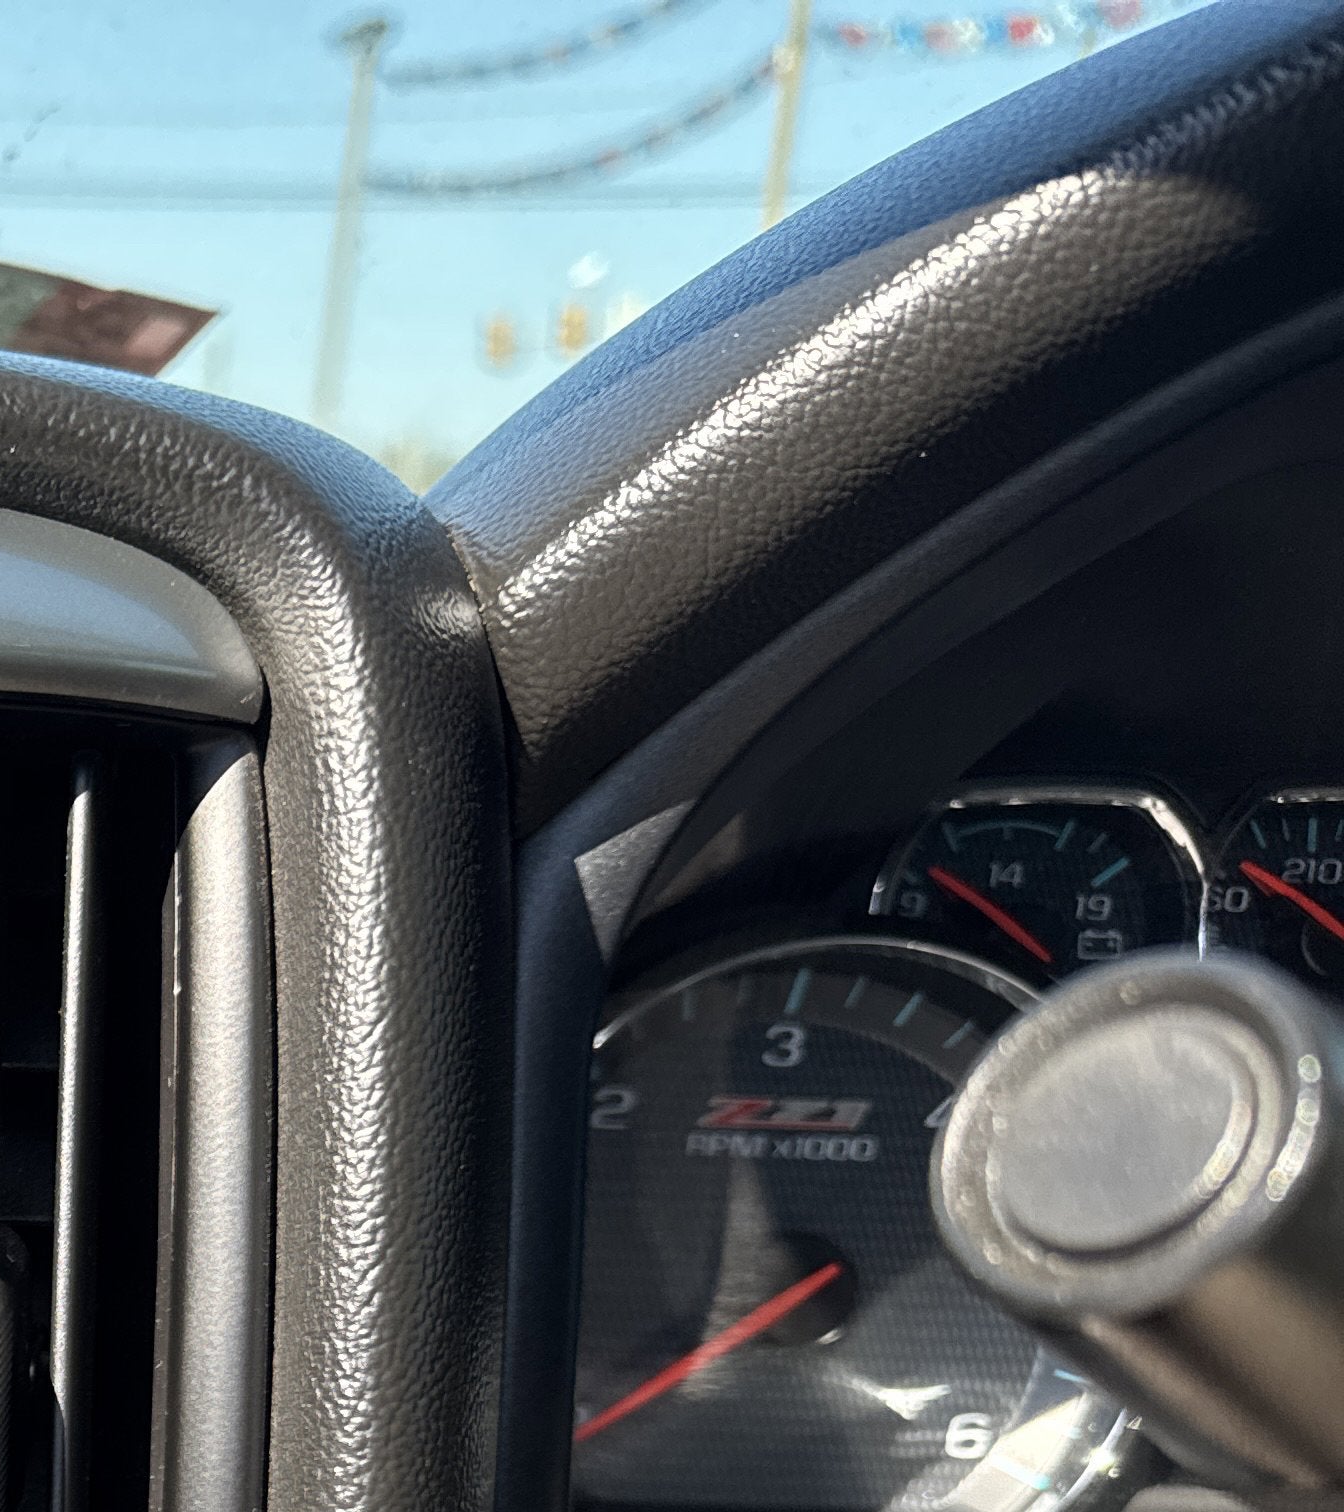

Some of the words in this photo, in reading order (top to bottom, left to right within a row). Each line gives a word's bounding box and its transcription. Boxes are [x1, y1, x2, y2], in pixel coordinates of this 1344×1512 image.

[988, 859, 1024, 889] 14
[1281, 857, 1344, 886] 210
[1075, 892, 1113, 922] 19
[760, 1022, 807, 1068] 3
[590, 1085, 640, 1130] 2
[685, 1130, 768, 1159] RPM
[771, 1133, 880, 1163] x1000
[944, 1411, 995, 1460] 6
